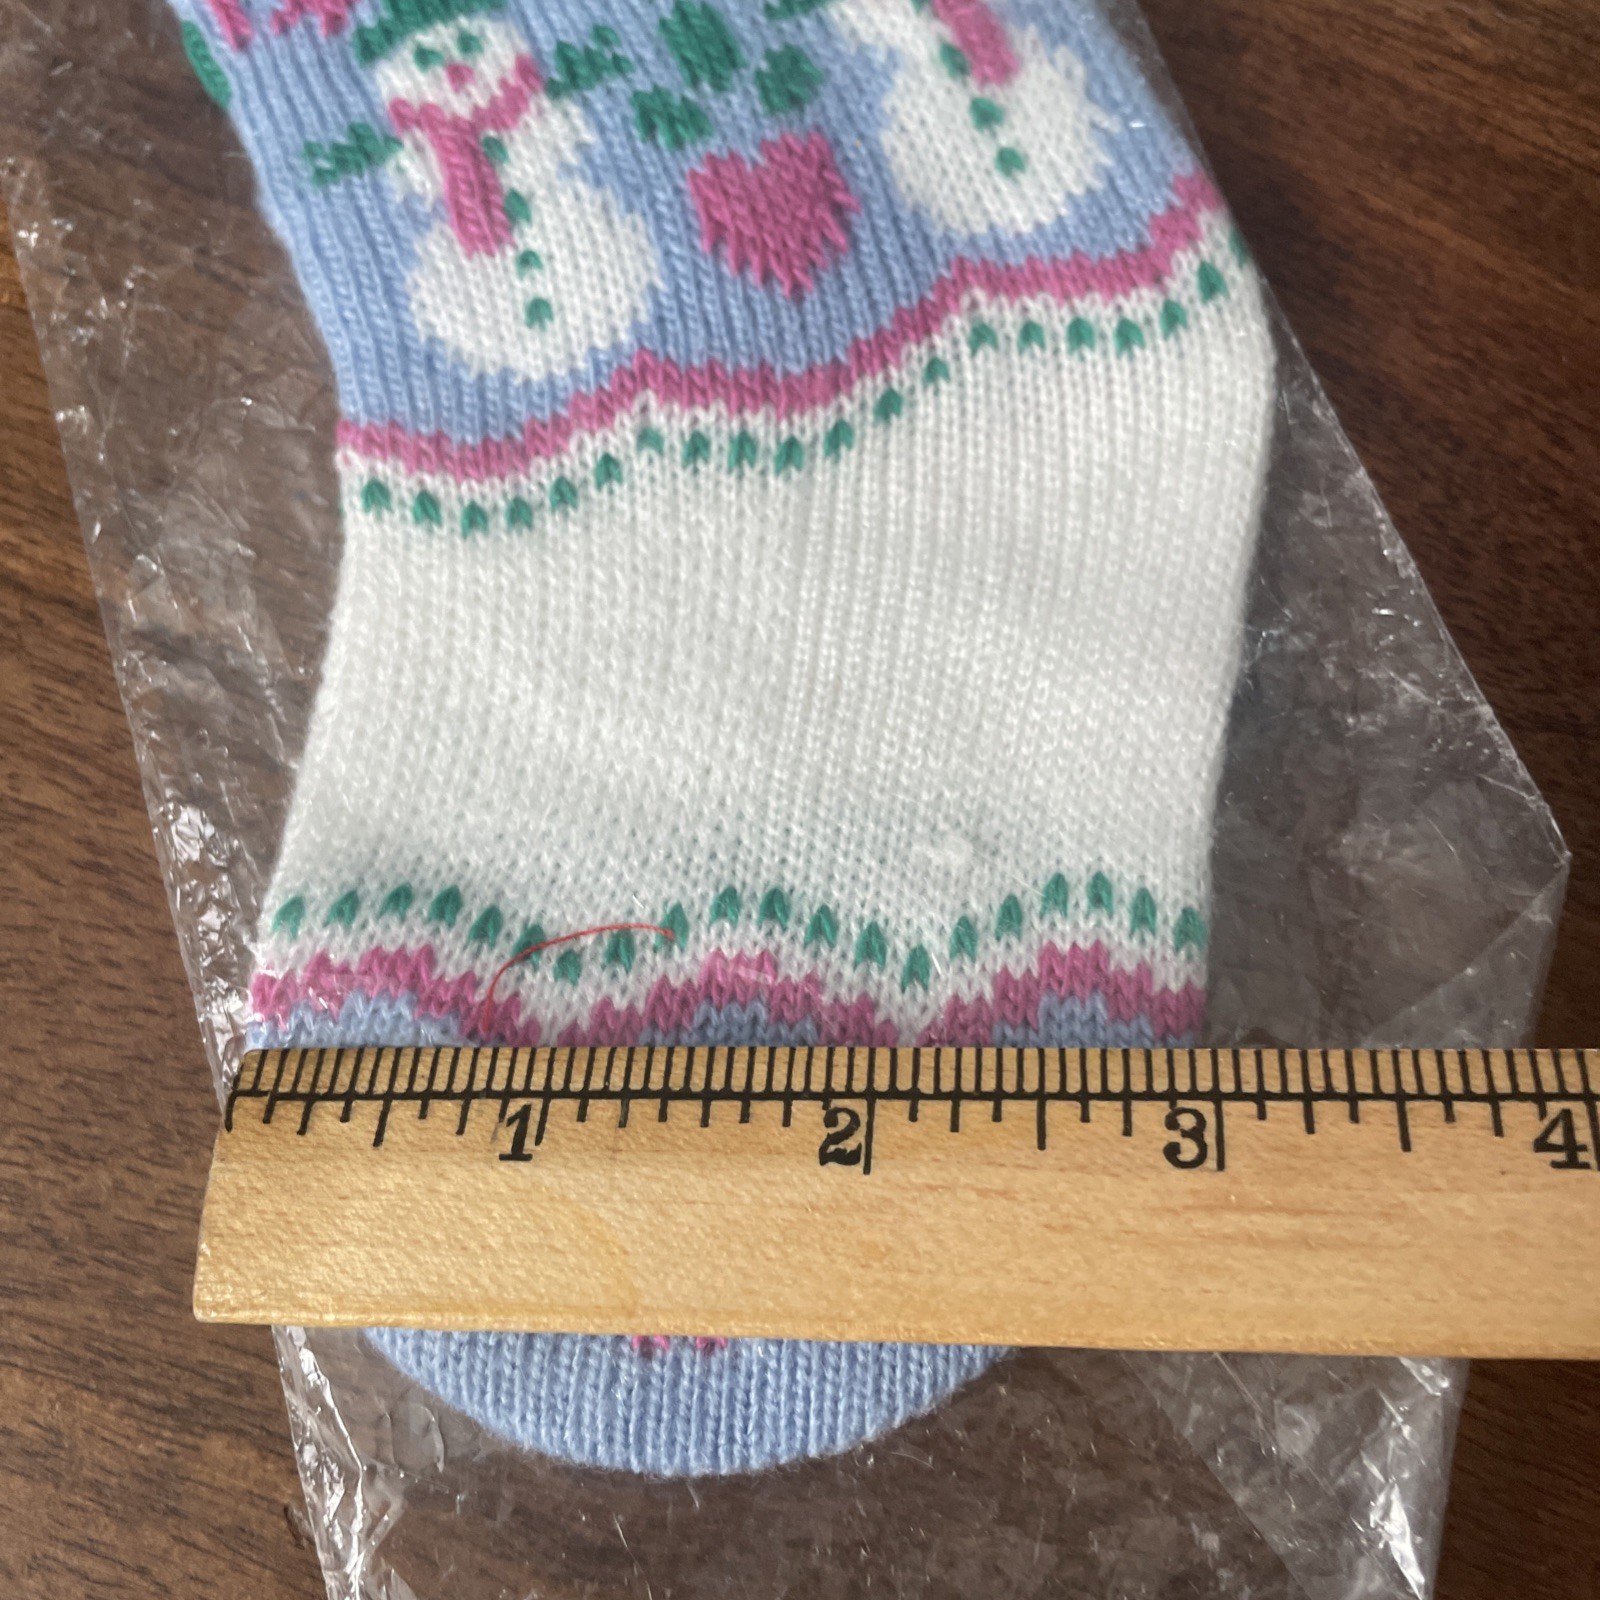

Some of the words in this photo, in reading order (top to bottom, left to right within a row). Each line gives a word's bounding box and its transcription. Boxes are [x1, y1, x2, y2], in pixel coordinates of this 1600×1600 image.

[498, 1104, 533, 1162] 1
[818, 1107, 863, 1167] 2
[1163, 1108, 1208, 1169] 3
[1533, 1109, 1590, 1170] 4
